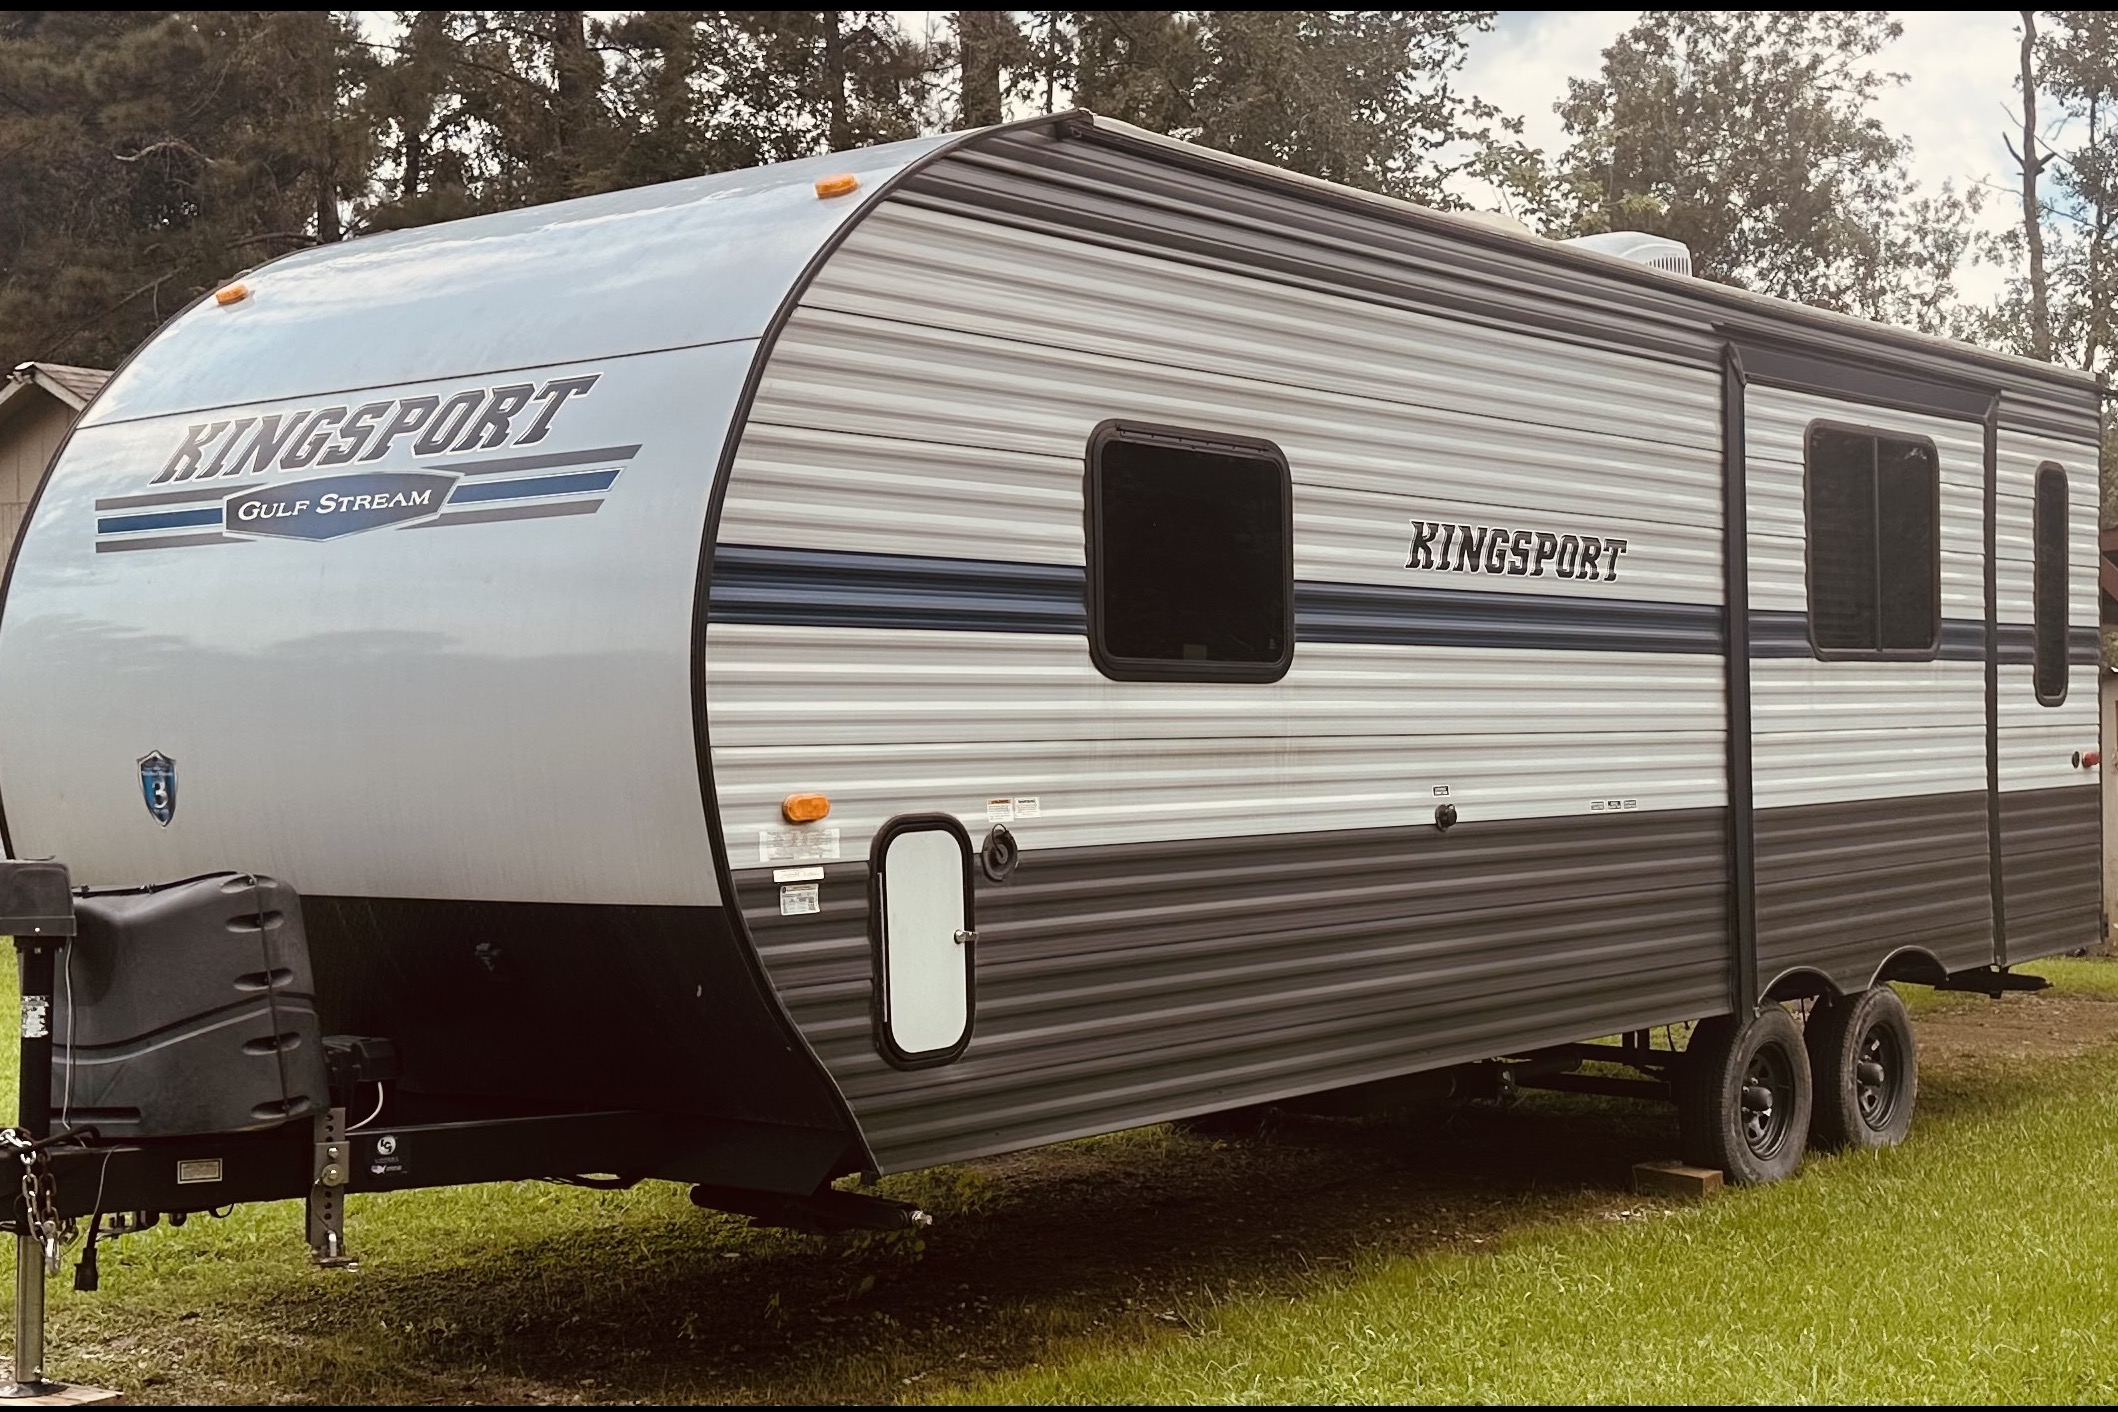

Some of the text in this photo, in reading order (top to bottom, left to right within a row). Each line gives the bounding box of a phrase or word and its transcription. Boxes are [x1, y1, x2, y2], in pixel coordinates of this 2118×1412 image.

[149, 372, 603, 486] KINGSPORT
[238, 489, 432, 520] GULF STREAM
[1404, 519, 1628, 583] KINGSPORT
